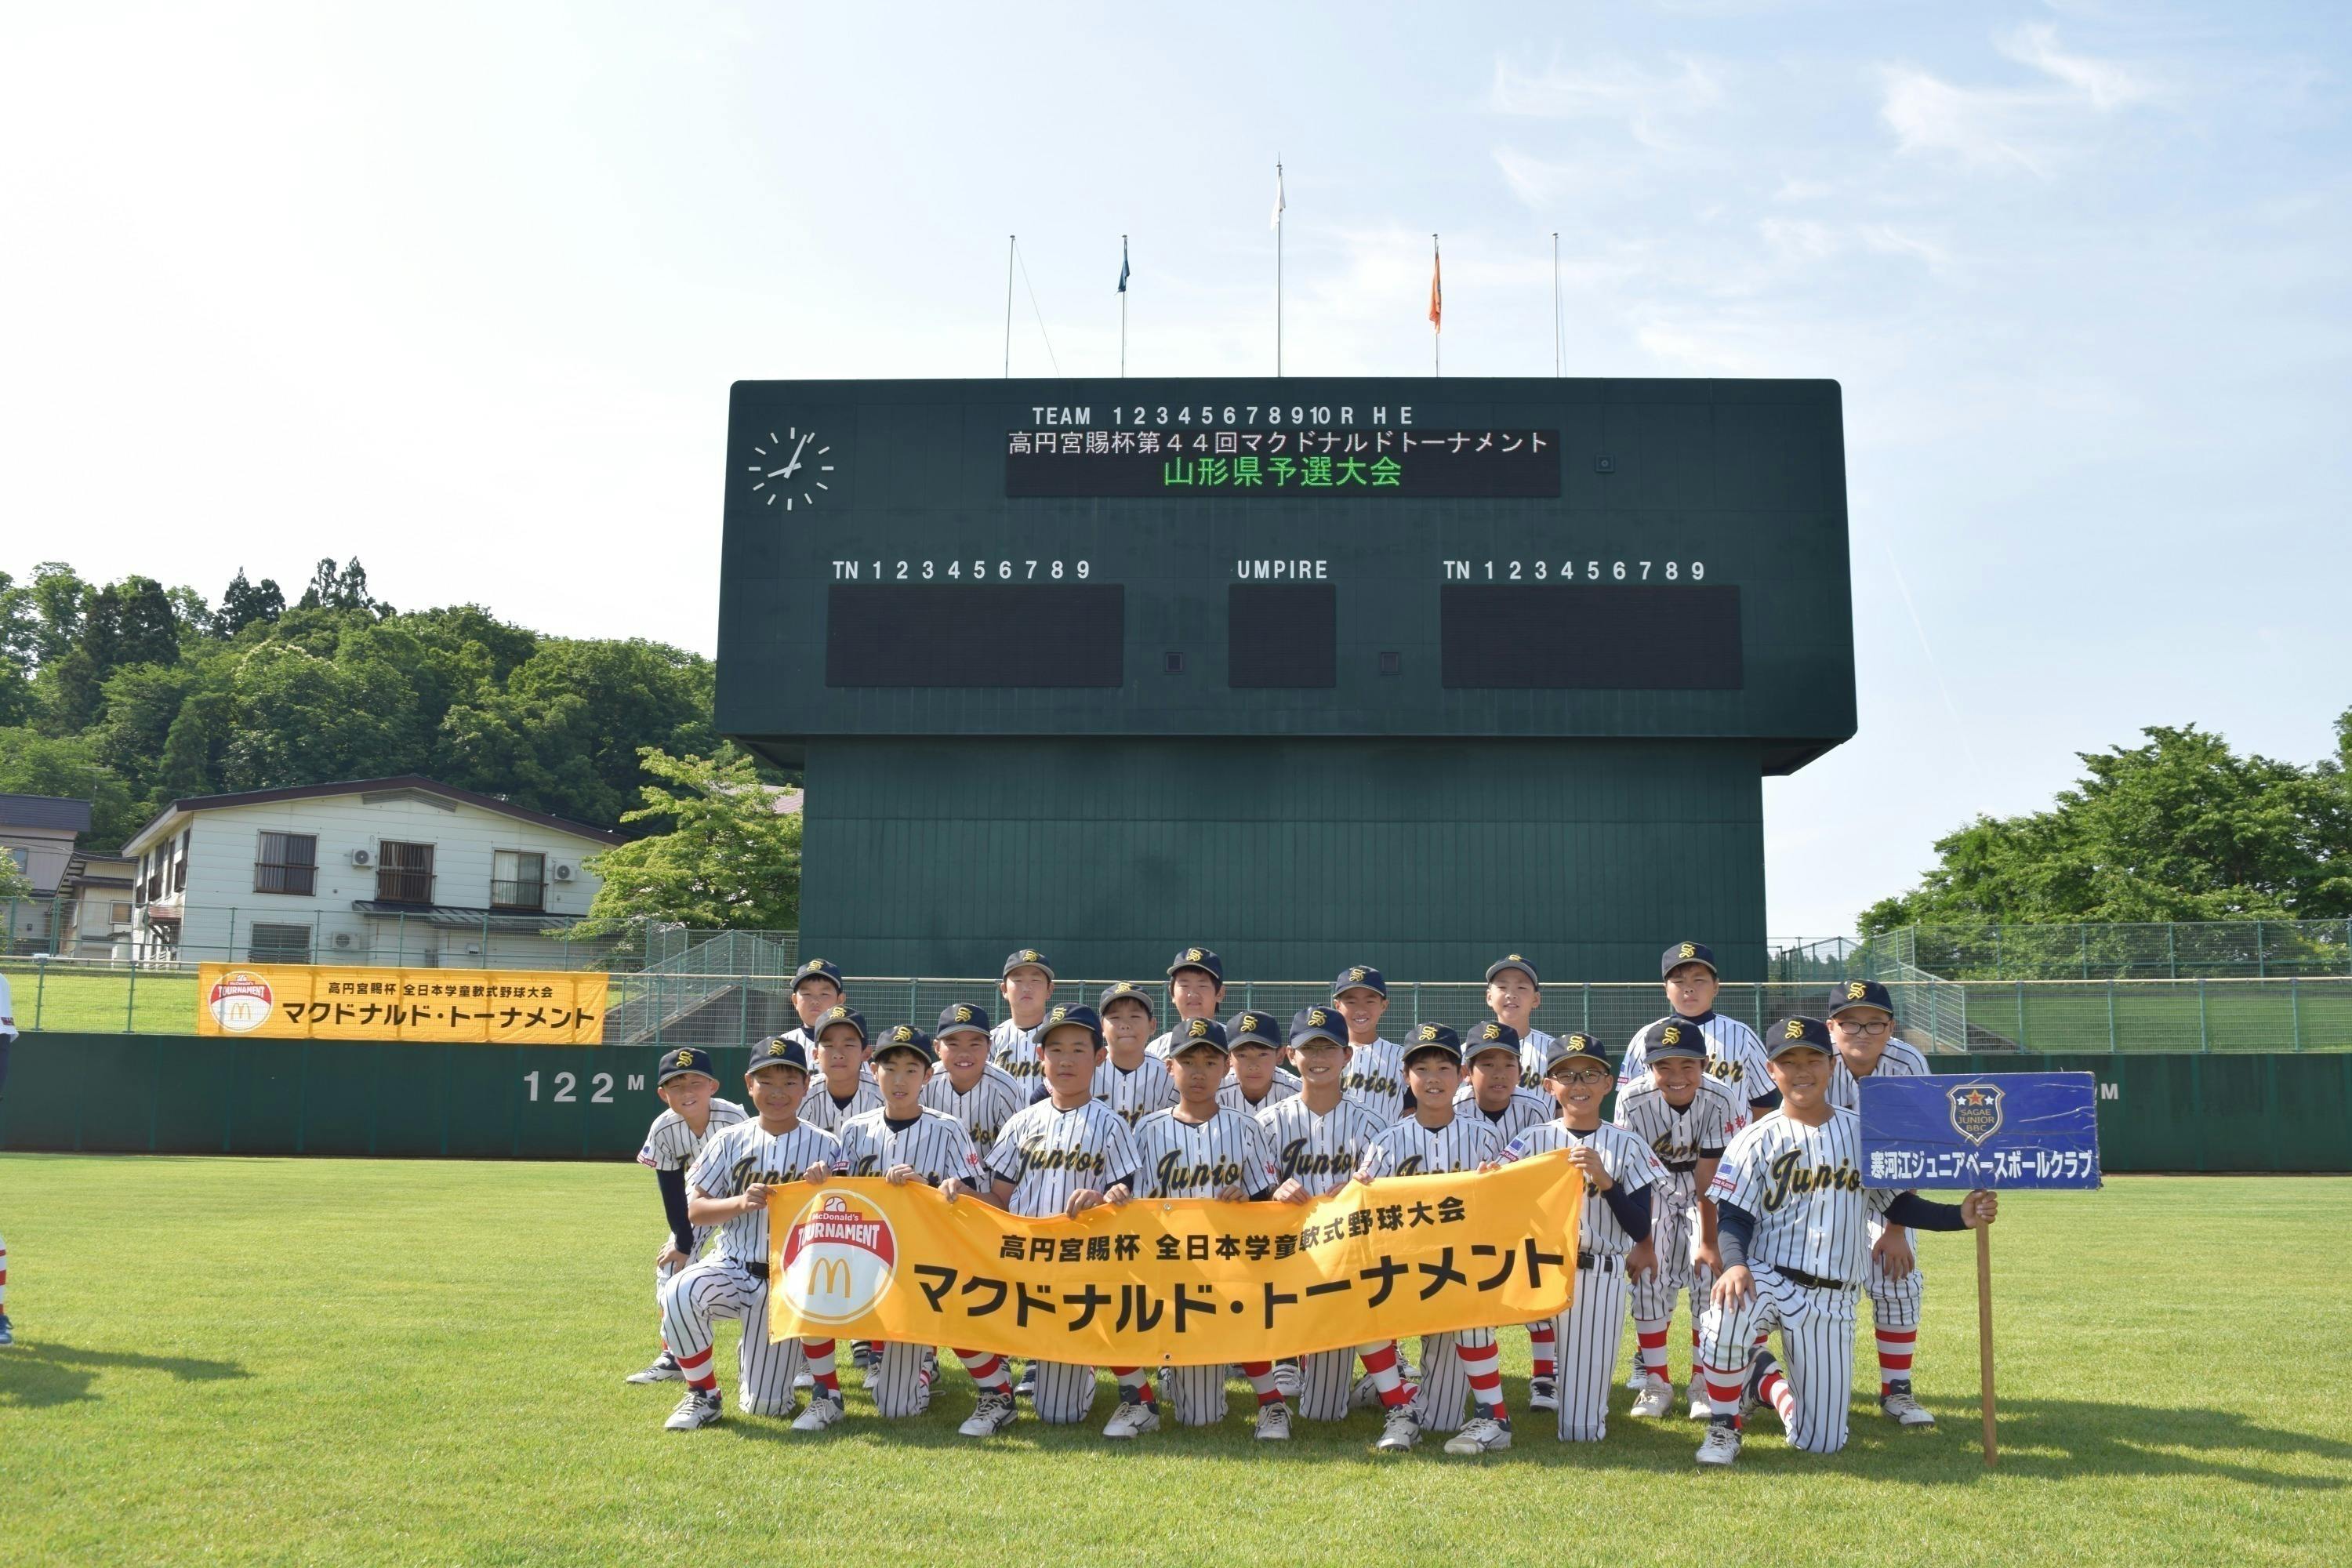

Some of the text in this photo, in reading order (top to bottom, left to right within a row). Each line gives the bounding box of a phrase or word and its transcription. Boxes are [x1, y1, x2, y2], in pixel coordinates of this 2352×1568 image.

[1032, 406, 1412, 425] TEAM 1 2 3 4 5 6 7 8 9 10 R H E
[1164, 456, 1403, 487] 山形県予選大会
[832, 560, 1090, 579] TN 1 2 3 4 5 6 7 8 9
[1237, 560, 1327, 579] UMPIRE
[1443, 561, 1704, 580] TN 1 2 3 4 5 6 7 8 9
[218, 985, 265, 998] TOURNAMENT
[328, 982, 554, 998] 高円宮賜杯 全日本学童軟式野球大会
[1847, 982, 1867, 1000] S
[282, 1002, 595, 1029] マクドナルド・トーナメント
[1307, 1010, 1327, 1027] S
[1662, 1027, 1681, 1045] S
[1784, 1020, 1805, 1040] S
[768, 1040, 787, 1055] S
[1567, 1035, 1586, 1051] S
[677, 1051, 694, 1067] S
[1706, 1051, 1744, 1083] ior
[627, 1074, 645, 1091] M
[1340, 1069, 1398, 1098] unior
[2100, 1083, 2118, 1100] M
[1957, 1116, 1995, 1124] JUNIOR
[1016, 1134, 1106, 1185] Junior
[1281, 1138, 1359, 1182] Junio
[1870, 1149, 2093, 1180] 寒河江ジュニアベースボールクラブ
[1148, 1149, 1246, 1198] Junio
[1763, 1148, 1862, 1213] Junio
[811, 1213, 859, 1221] McDonald's
[797, 1222, 880, 1253] TOURNAMENT
[999, 1196, 1467, 1263] 高円宮賜杯 全日本学童軟式野球大会
[913, 1237, 1565, 1333] マクドナルド・トーナメント
